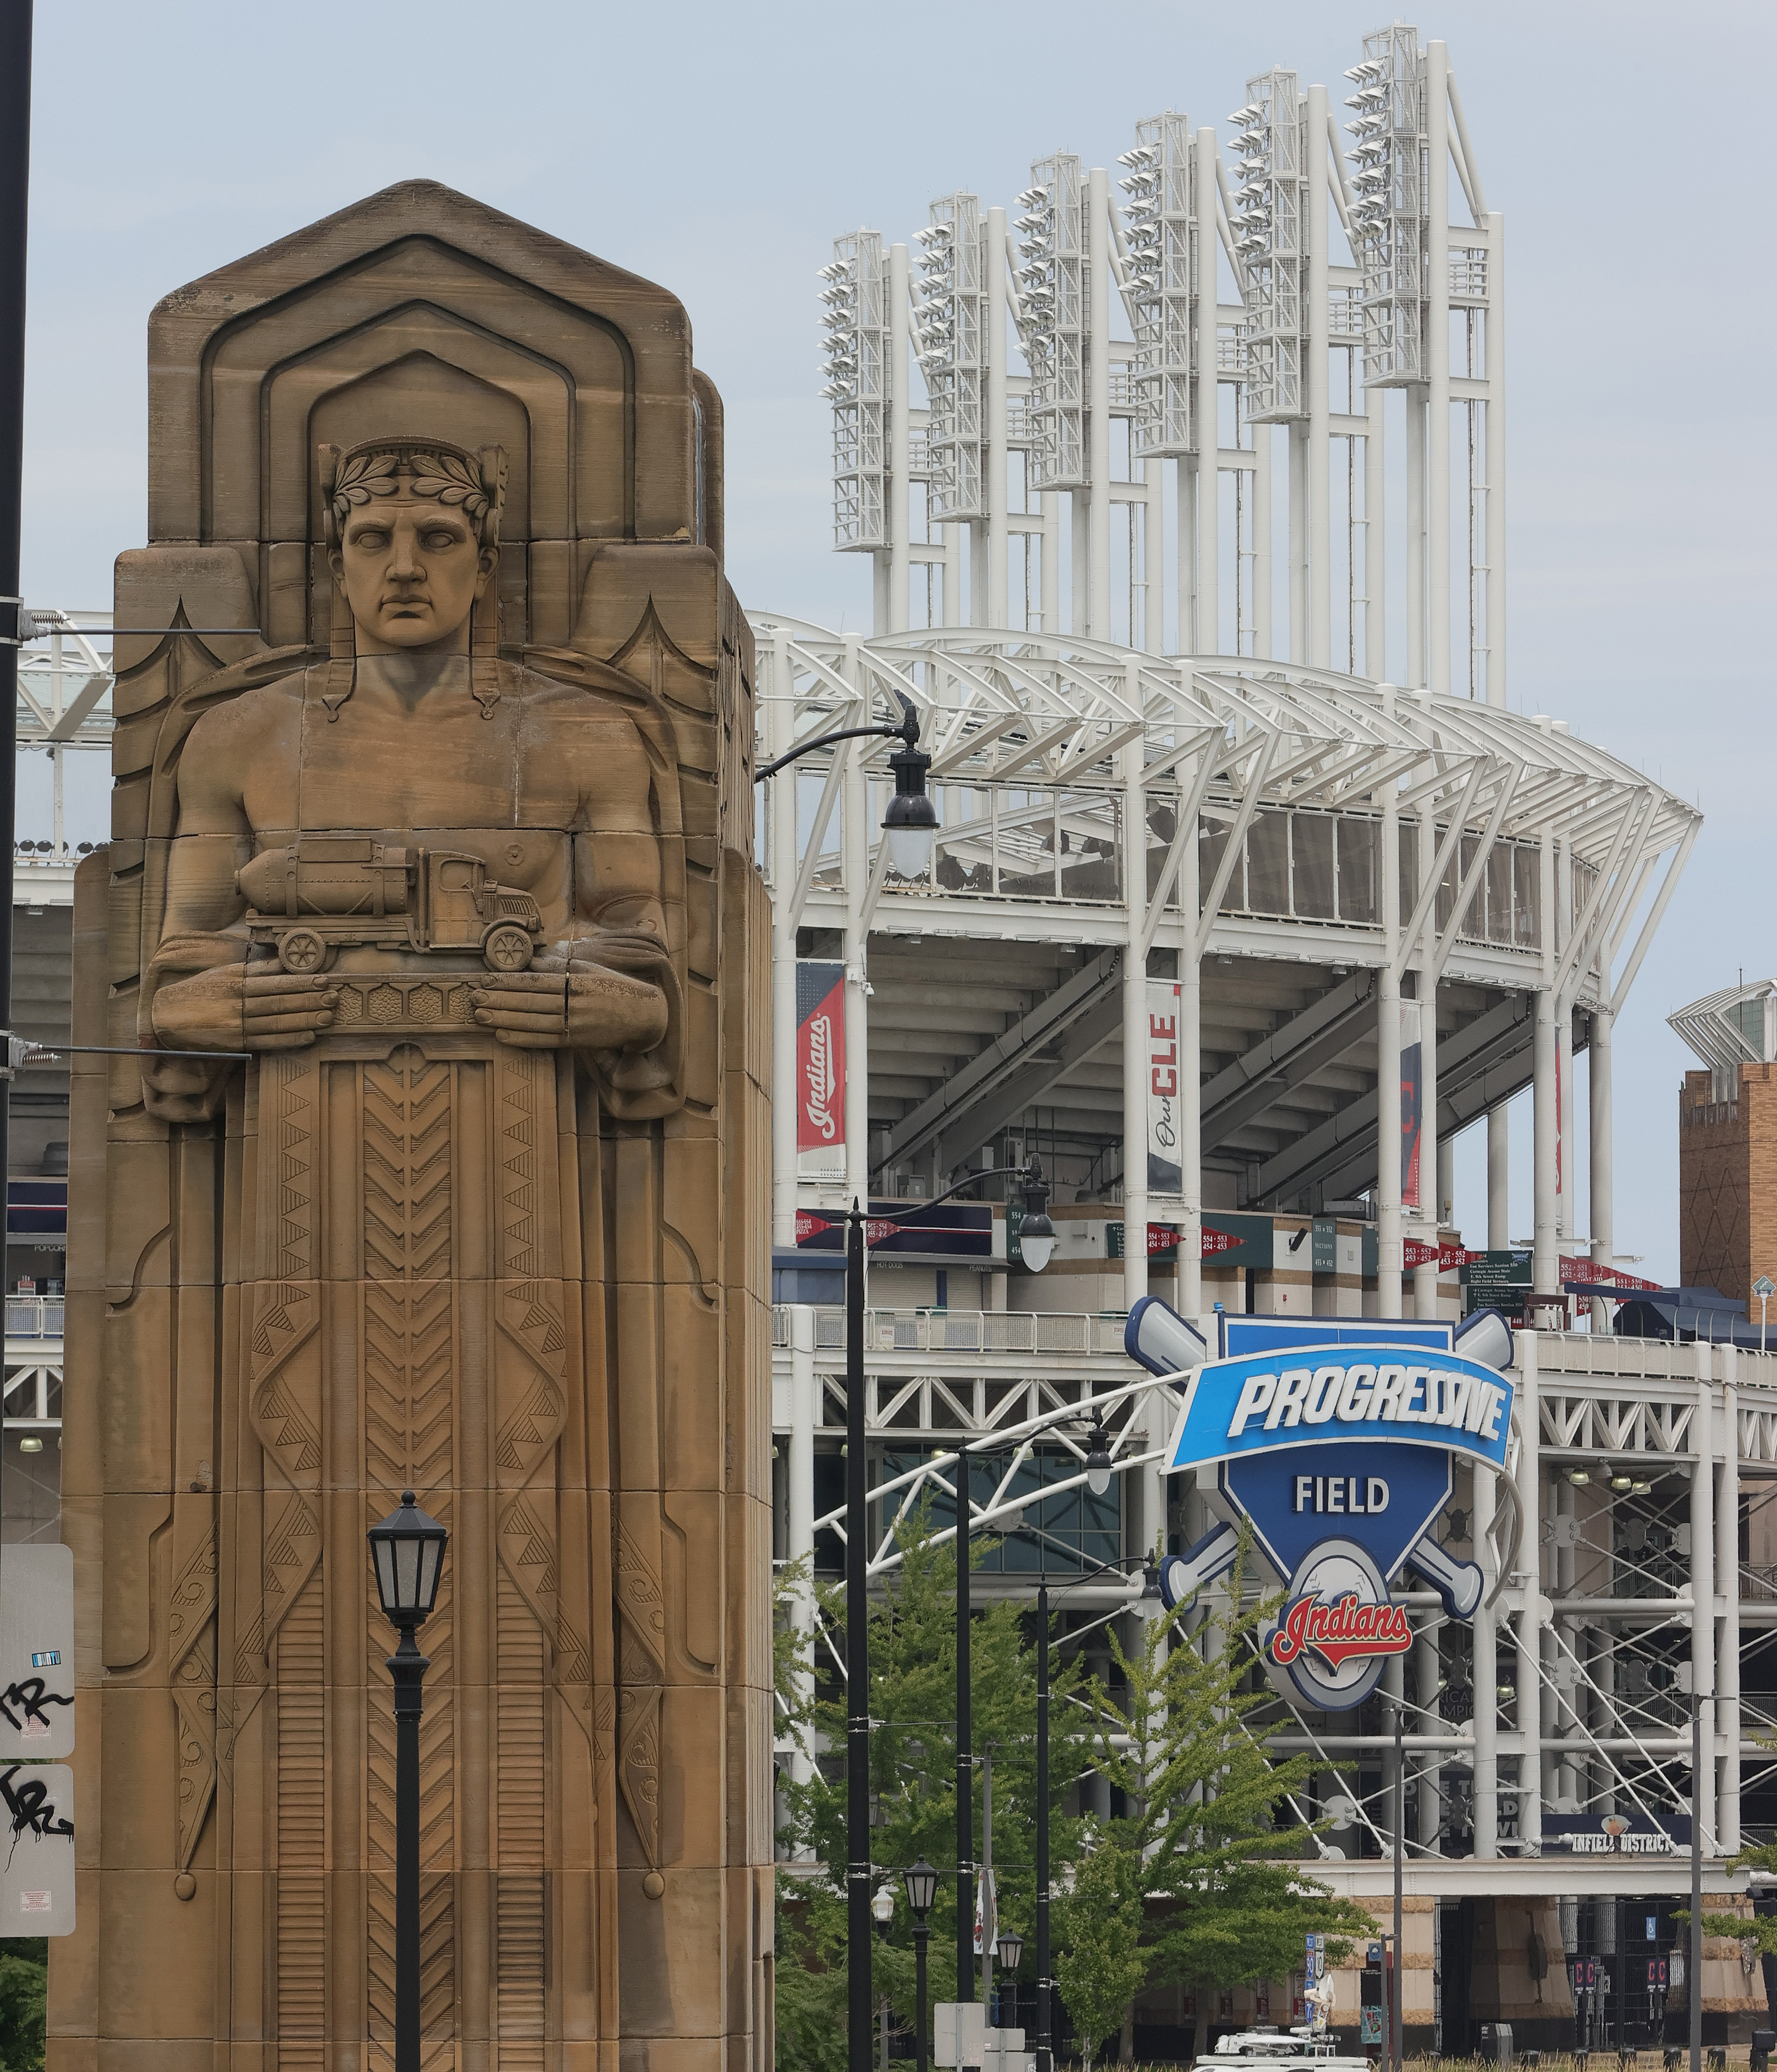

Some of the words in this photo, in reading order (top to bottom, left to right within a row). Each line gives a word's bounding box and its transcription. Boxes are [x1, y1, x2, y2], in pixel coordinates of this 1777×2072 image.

[1150, 1013, 1176, 1097] CLE
[806, 1015, 836, 1139] Indians
[1156, 1092, 1176, 1147] Our
[1227, 1364, 1507, 1441] PROGRESSIVE
[1295, 1476, 1390, 1514] FIELD
[1272, 1592, 1413, 1670] Indians
[1620, 1834, 1671, 1852] DISTRICT
[1307, 1957, 1314, 1973] 90
[1576, 1963, 1583, 1983] C
[1588, 1963, 1594, 1983] C
[1648, 1962, 1655, 1981] C
[1659, 1961, 1665, 1981] C
